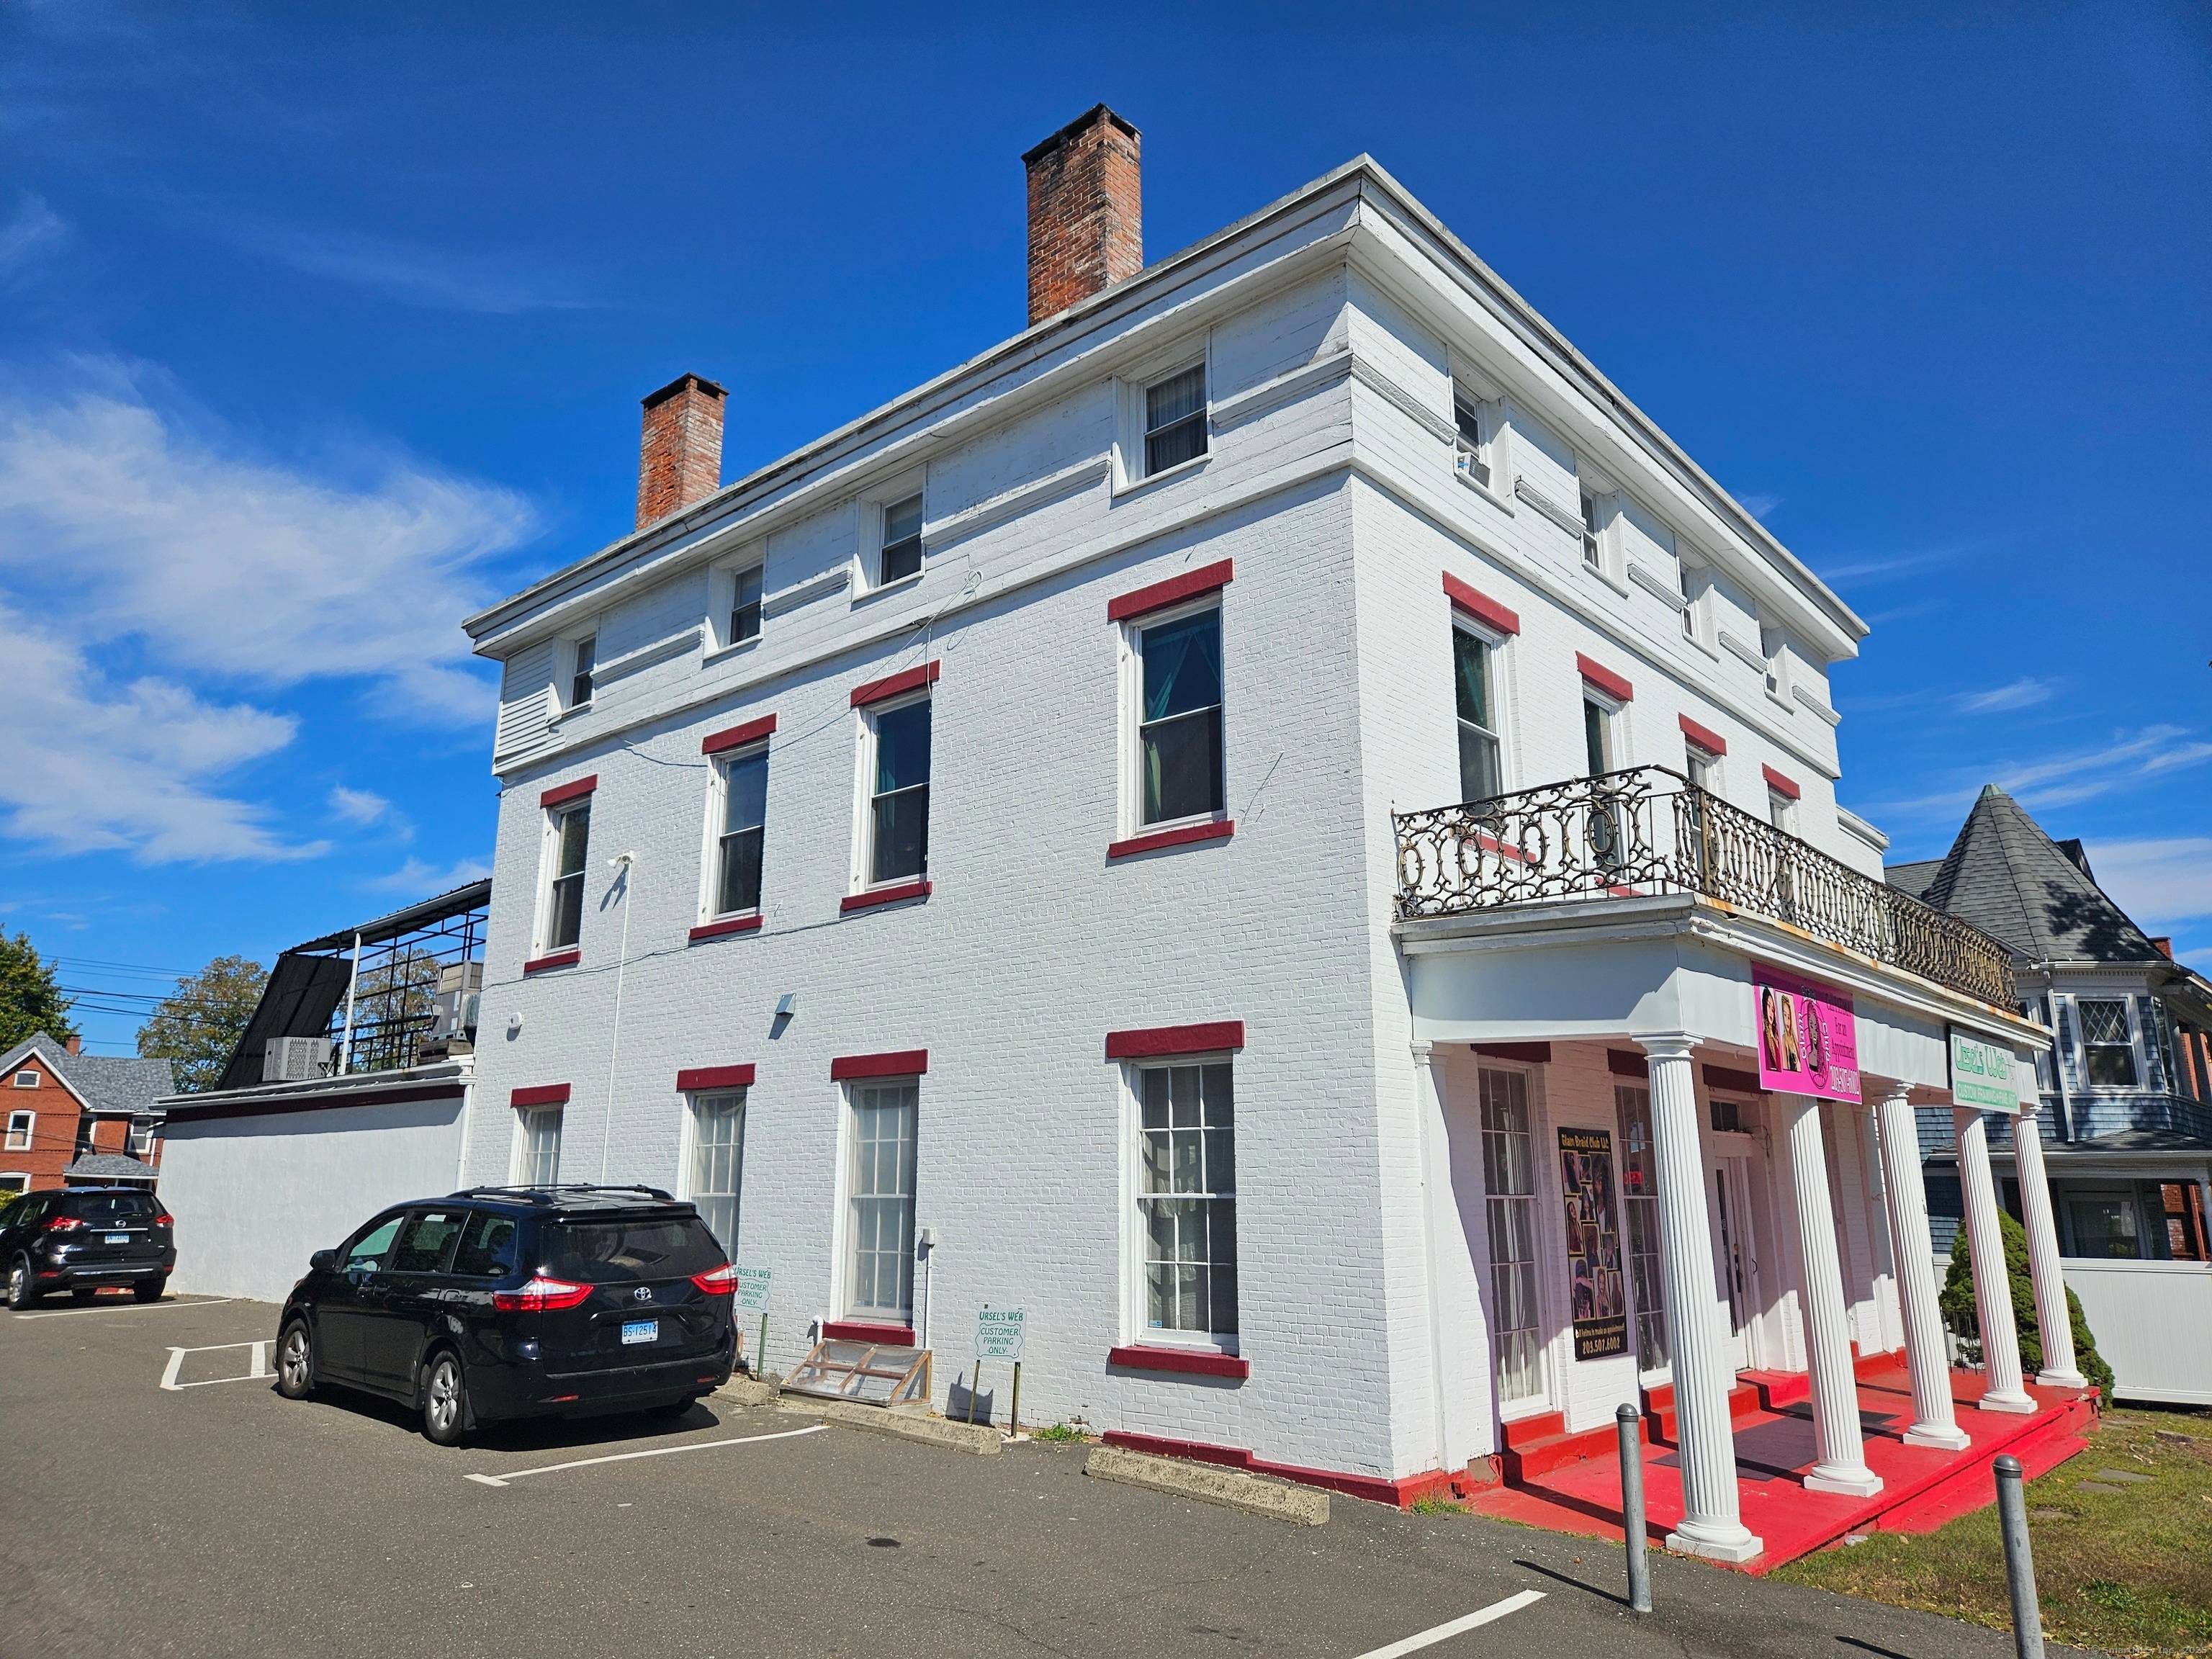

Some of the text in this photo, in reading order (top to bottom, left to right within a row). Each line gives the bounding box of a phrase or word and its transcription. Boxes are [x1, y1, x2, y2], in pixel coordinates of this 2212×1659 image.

[1561, 1133, 1575, 1146] Glam
[1575, 1135, 1589, 1147] Braid
[1589, 1136, 1601, 1148] Club
[758, 1269, 771, 1279] WEB
[739, 1281, 767, 1291] USTOMER
[737, 1290, 763, 1298] PARKING
[979, 1311, 1023, 1321] URSEL'S WEB
[980, 1327, 1020, 1336] CUSTOMER
[983, 1336, 1014, 1345] PARKING
[1582, 1336, 1620, 1354] 203.507.6002
